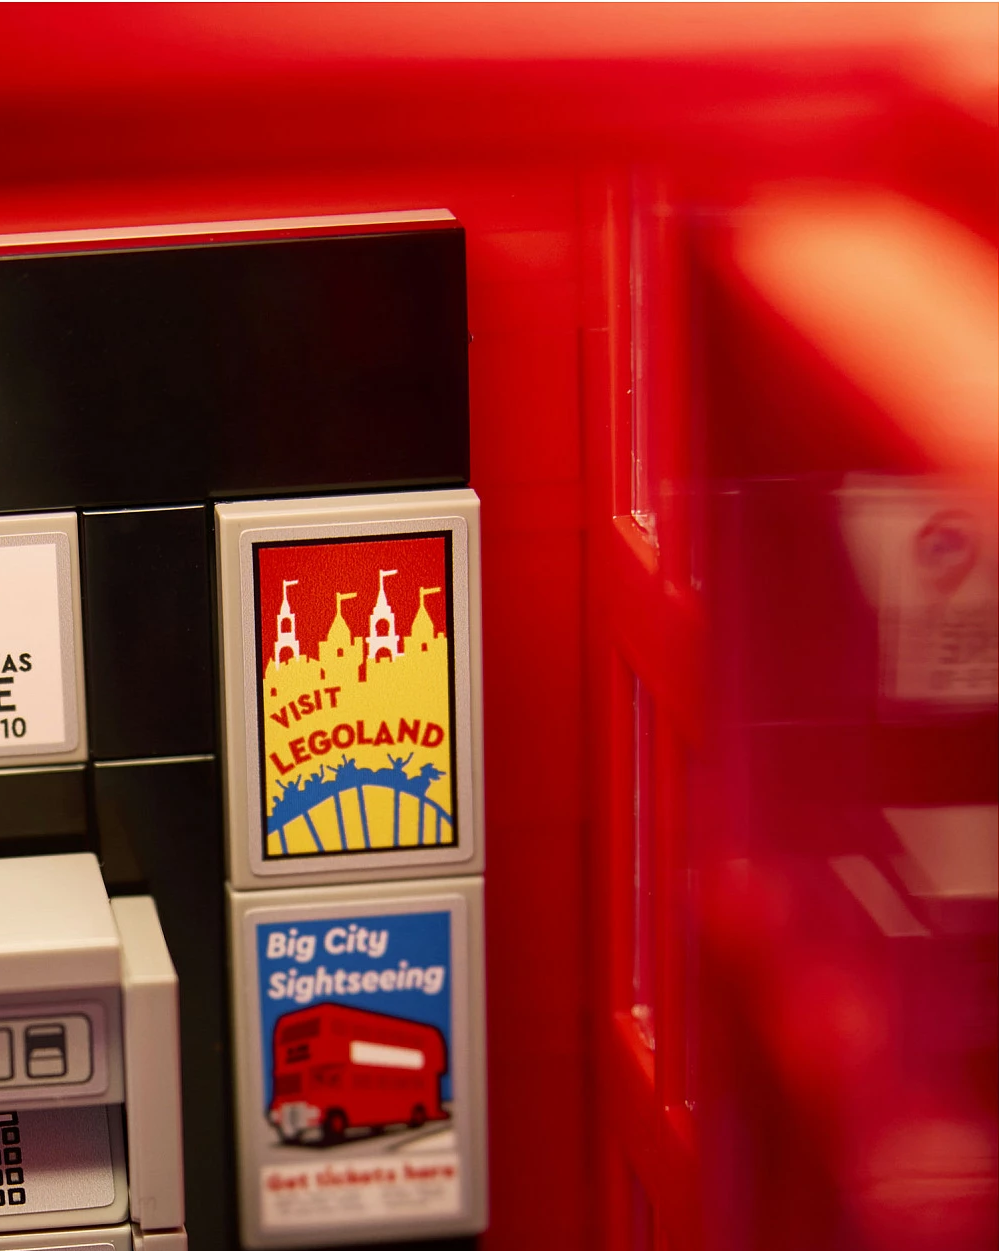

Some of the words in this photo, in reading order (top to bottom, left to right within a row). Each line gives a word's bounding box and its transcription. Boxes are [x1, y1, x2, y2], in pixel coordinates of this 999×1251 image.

[270, 686, 341, 729] VISIT
[269, 718, 445, 775] LEGOLAND
[266, 928, 316, 963] Big
[324, 924, 389, 958] City
[267, 960, 445, 1004] Sightseeing
